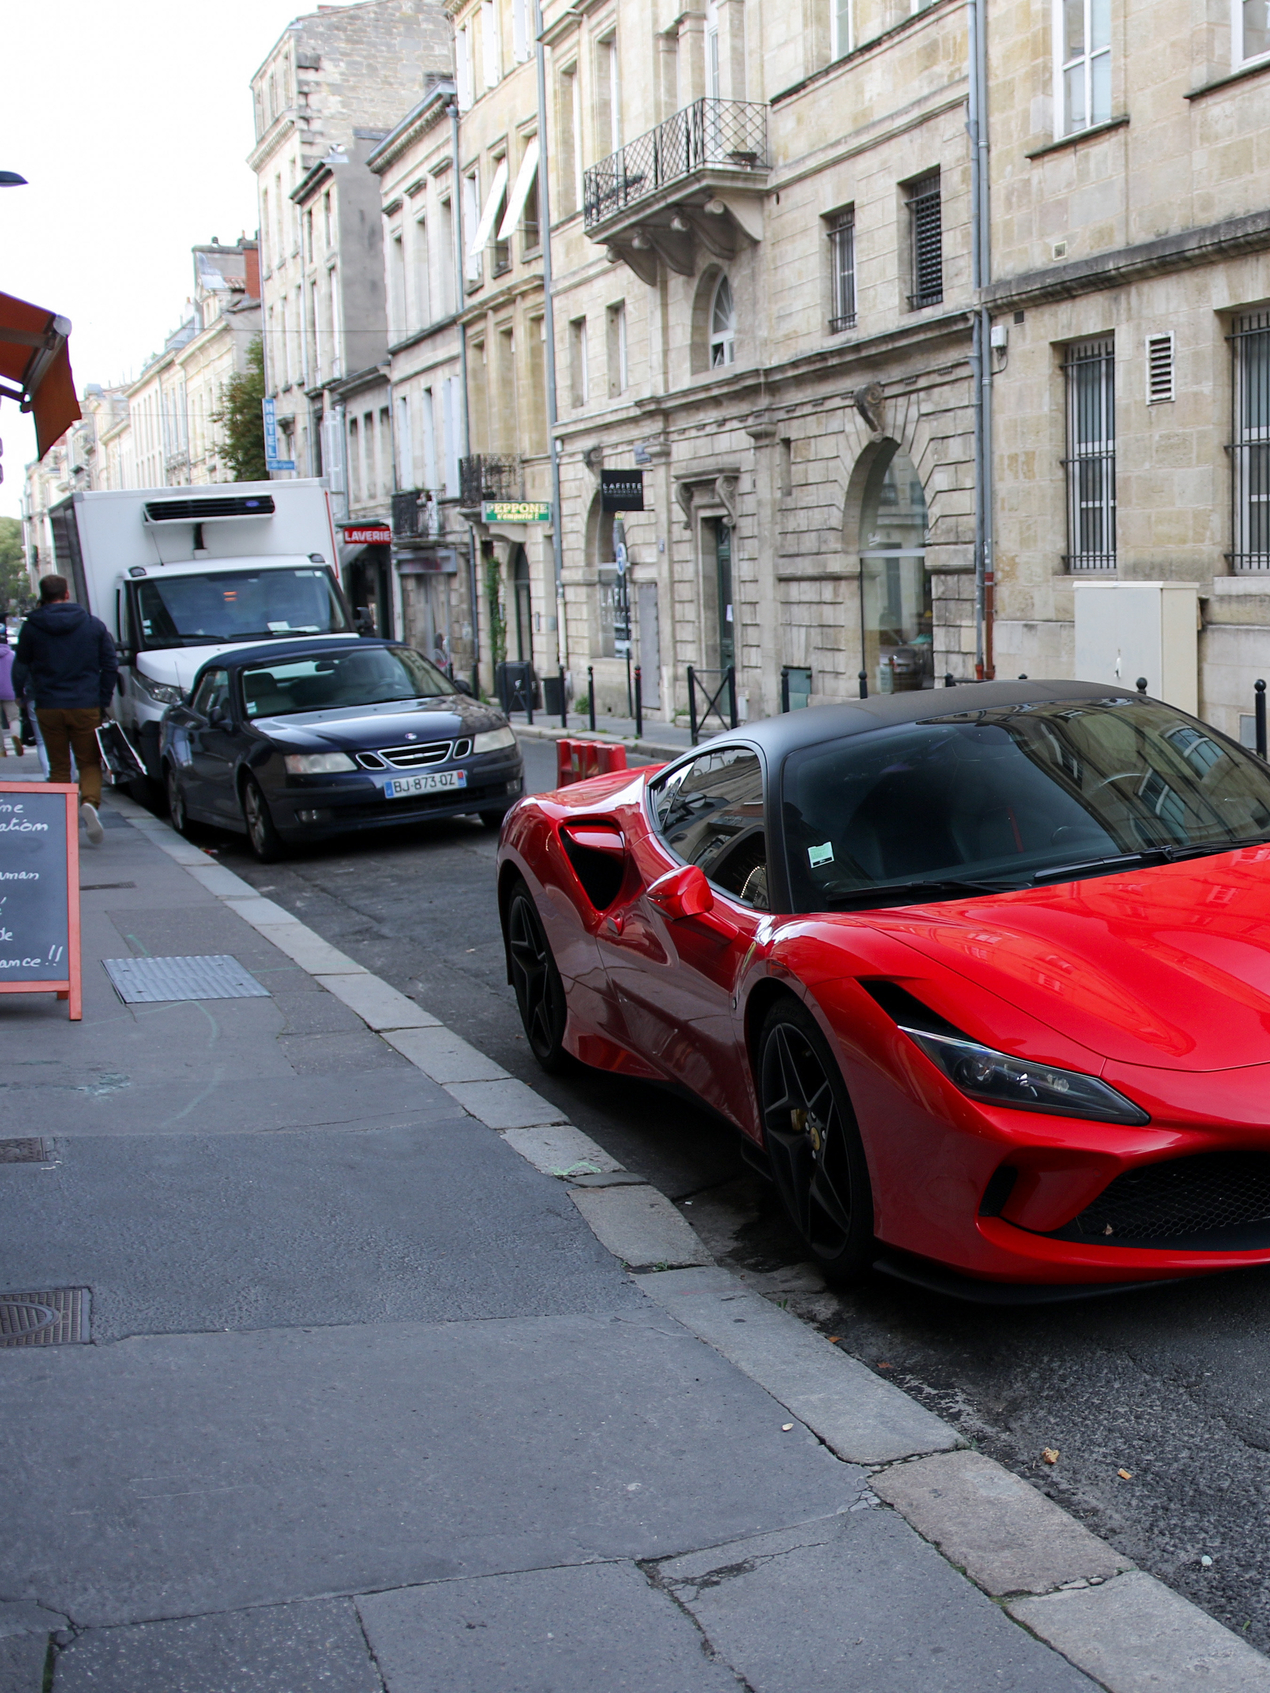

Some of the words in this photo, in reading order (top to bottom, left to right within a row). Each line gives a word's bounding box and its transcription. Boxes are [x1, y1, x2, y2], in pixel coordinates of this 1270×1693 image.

[265, 402, 276, 457] HOTEL
[486, 503, 548, 514] PEPPONE
[344, 531, 391, 541] LAVERIE
